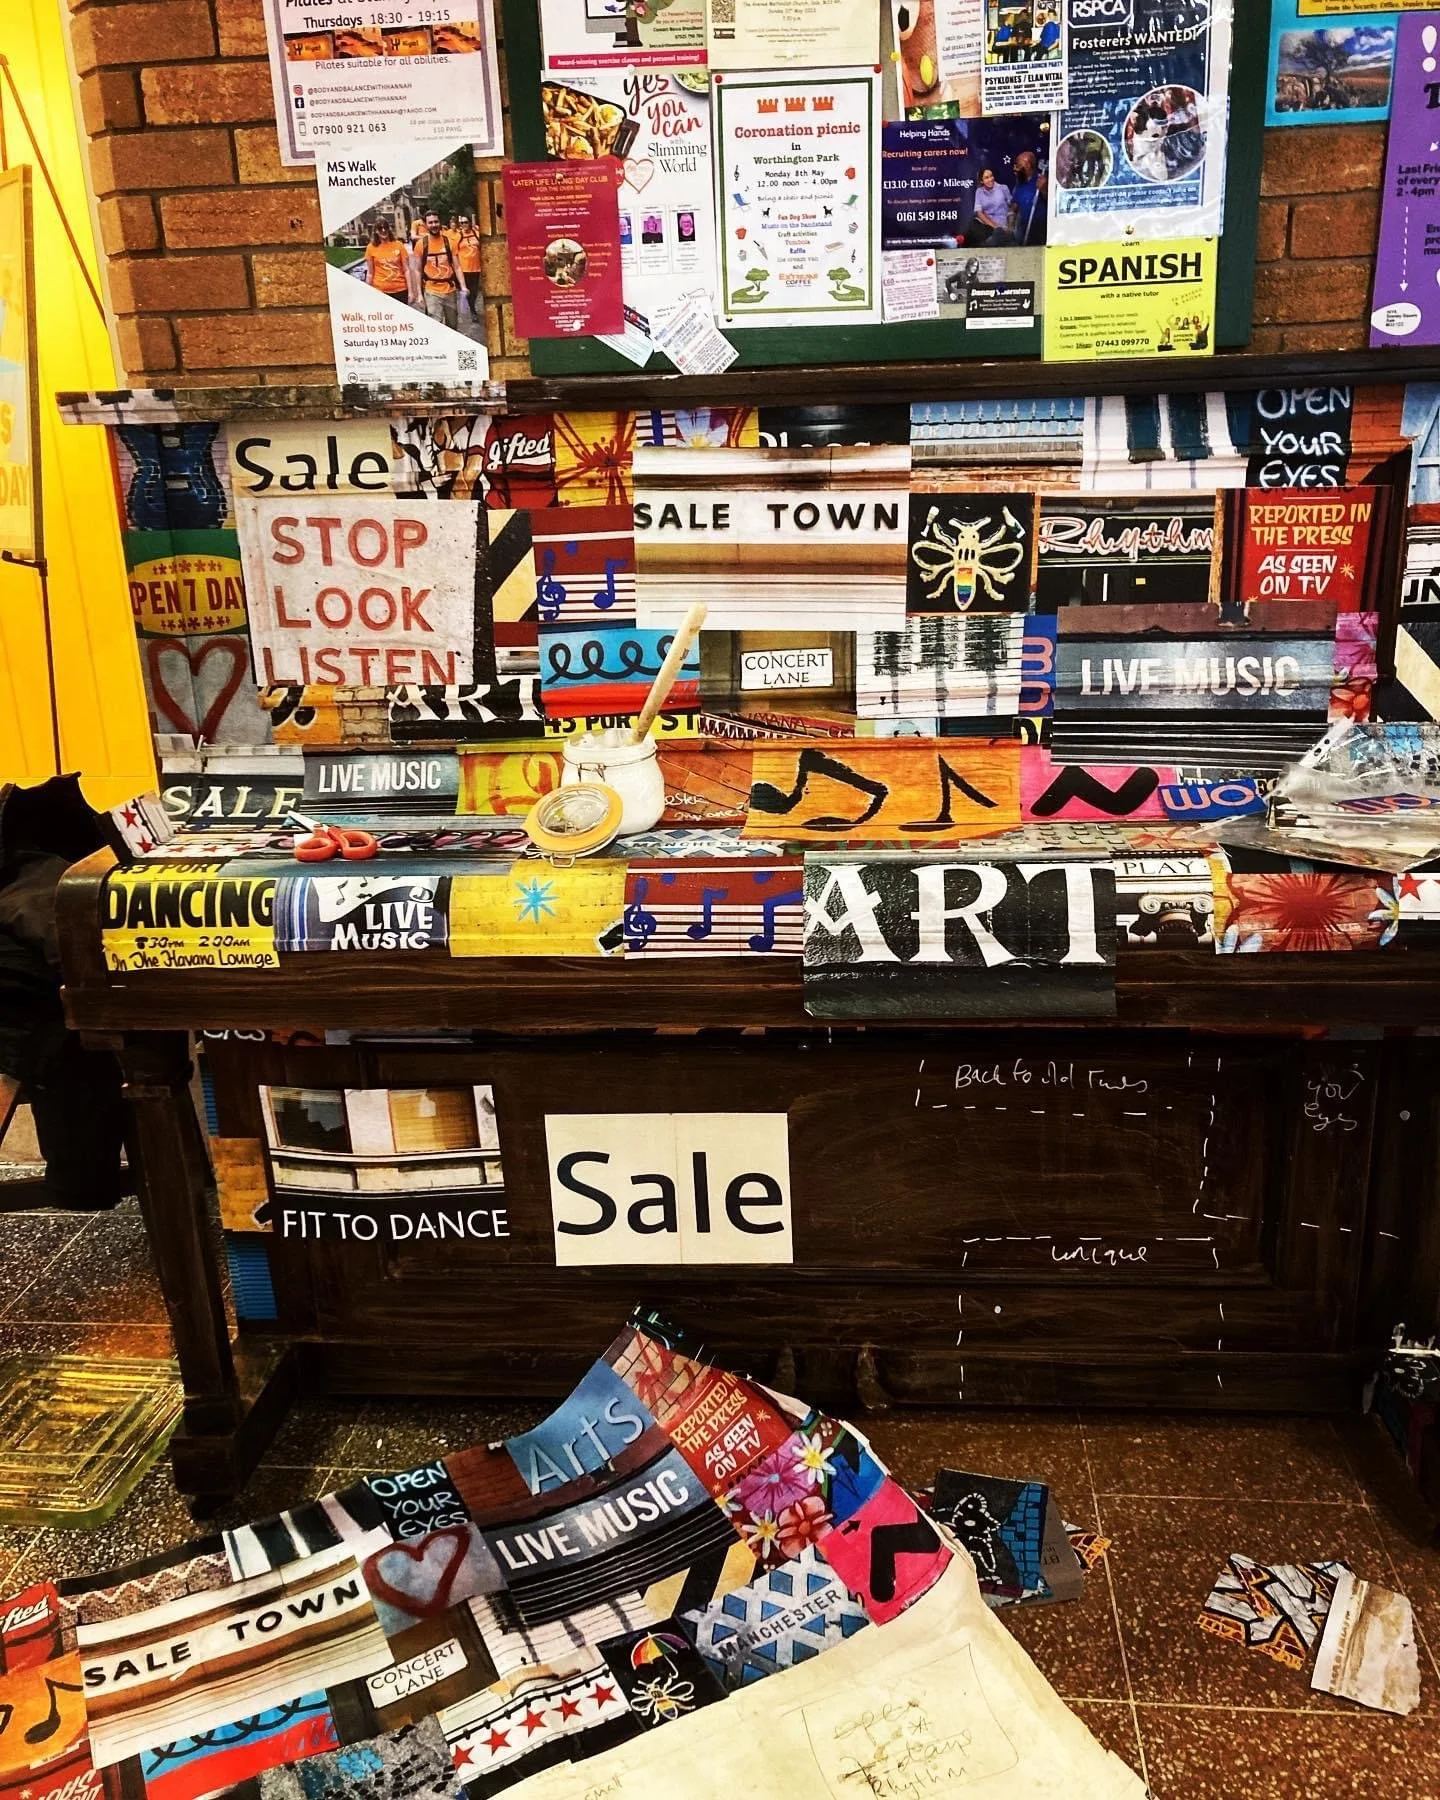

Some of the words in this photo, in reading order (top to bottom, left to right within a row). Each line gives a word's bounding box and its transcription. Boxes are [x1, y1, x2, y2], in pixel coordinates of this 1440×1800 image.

[304, 15, 363, 29] Thursdays
[370, 12, 402, 25] 18:30
[418, 10, 450, 22] 19:15
[1072, 0, 1127, 18] RSPCA
[1072, 35, 1130, 50] Fosterers
[316, 61, 345, 70] Pilates
[347, 59, 382, 68] suitable
[384, 58, 397, 67] for
[400, 57, 412, 65] all
[985, 75, 1022, 85] PSYKLONES
[648, 99, 688, 136] you
[662, 117, 703, 138] can
[312, 124, 343, 135] 07900
[347, 123, 365, 133] 921
[369, 123, 387, 132] 063
[734, 126, 813, 139] Coronation
[817, 122, 861, 138] picnic
[900, 130, 927, 140] Helping
[927, 129, 950, 137] Hands
[648, 143, 707, 157] Slimming
[791, 142, 801, 151] in
[882, 149, 916, 160] Recruiting
[917, 149, 948, 158] carers
[949, 147, 969, 156] now!
[327, 161, 346, 173] MS
[347, 160, 377, 172] Walk
[660, 159, 697, 173] World
[753, 155, 814, 165] Worthington
[817, 154, 840, 163] Park
[1398, 164, 1421, 175] Last
[328, 175, 396, 187] Manchester
[765, 171, 791, 180] Monday
[795, 170, 809, 178] 8th
[943, 178, 974, 189] Mileage
[1397, 174, 1408, 186] of
[1410, 186, 1435, 198] 4pm
[896, 210, 916, 222] 0161
[918, 210, 935, 221] 549
[936, 210, 958, 221] 1848
[1058, 252, 1202, 285] SPANISH
[1100, 291, 1114, 299] with
[1121, 291, 1142, 299] native
[1143, 290, 1160, 298] tutor
[341, 313, 366, 323] Walk,
[367, 312, 382, 321] roll
[383, 313, 394, 321] or
[342, 324, 366, 334] stroll
[367, 324, 376, 333] to
[377, 324, 398, 335] stop
[399, 323, 414, 333] MS
[343, 338, 380, 350] Saturday
[381, 338, 389, 347] 13
[390, 338, 408, 348] May
[409, 337, 430, 346] 2023
[1095, 339, 1120, 347] 07443
[1121, 338, 1150, 346] 099770
[488, 432, 552, 470] gifted
[1260, 427, 1345, 457] YOUR
[235, 435, 390, 492] Sale
[1260, 460, 1341, 488] EYES
[633, 502, 730, 530] SALE
[767, 502, 899, 531] TOWN
[1249, 504, 1346, 525] REPORTED
[1350, 503, 1371, 523] IN
[271, 516, 429, 569] STOP
[1038, 515, 1215, 563] Rhythm
[1251, 526, 1289, 546] THE
[1292, 525, 1354, 545] PRESS
[1258, 555, 1287, 574] AS
[1288, 555, 1338, 574] SEEN
[183, 578, 196, 612] 7
[1260, 576, 1291, 595] ON
[274, 585, 434, 632] LOOK
[262, 647, 457, 687] LISTEN
[744, 653, 829, 671] CONCERT
[763, 672, 810, 686] LANE
[1080, 658, 1163, 697] LIVE
[1172, 655, 1302, 697] MUSIC
[319, 764, 366, 793] LIVE
[371, 761, 442, 791] MUSIC
[161, 786, 303, 818] SALE
[1122, 861, 1196, 876] PLAY
[103, 880, 277, 929] DANCING
[803, 863, 1118, 968] ART
[364, 902, 433, 930] LIVE
[112, 953, 128, 971] In
[129, 951, 160, 969] The
[160, 949, 215, 968] Havana
[219, 949, 275, 968] Lounge
[955, 1063, 1007, 1090] Back
[1013, 1058, 1032, 1084] to
[556, 1151, 785, 1235] Sale
[282, 1209, 328, 1239] FIT
[332, 1212, 379, 1241] TO
[391, 1209, 510, 1241] DANCE
[1051, 1245, 1148, 1265] unique
[669, 1376, 729, 1445] REPORTED
[680, 1422, 712, 1455] THE
[708, 1390, 749, 1436] PRESS
[528, 1396, 645, 1496] Arts
[703, 1444, 728, 1469] AS
[724, 1418, 756, 1452] SEEN
[712, 1455, 738, 1480] ON
[369, 1462, 450, 1497] OPEN
[383, 1490, 460, 1521] YOUR
[398, 1511, 470, 1538] EYES
[495, 1523, 582, 1571] LIVE
[585, 1469, 691, 1548] MUSIC
[83, 1641, 193, 1688] SALE
[226, 1579, 361, 1643] TOWN
[717, 1587, 845, 1659] MANCHESTER
[370, 1638, 458, 1691] CONCERT
[394, 1665, 445, 1698] LANE
